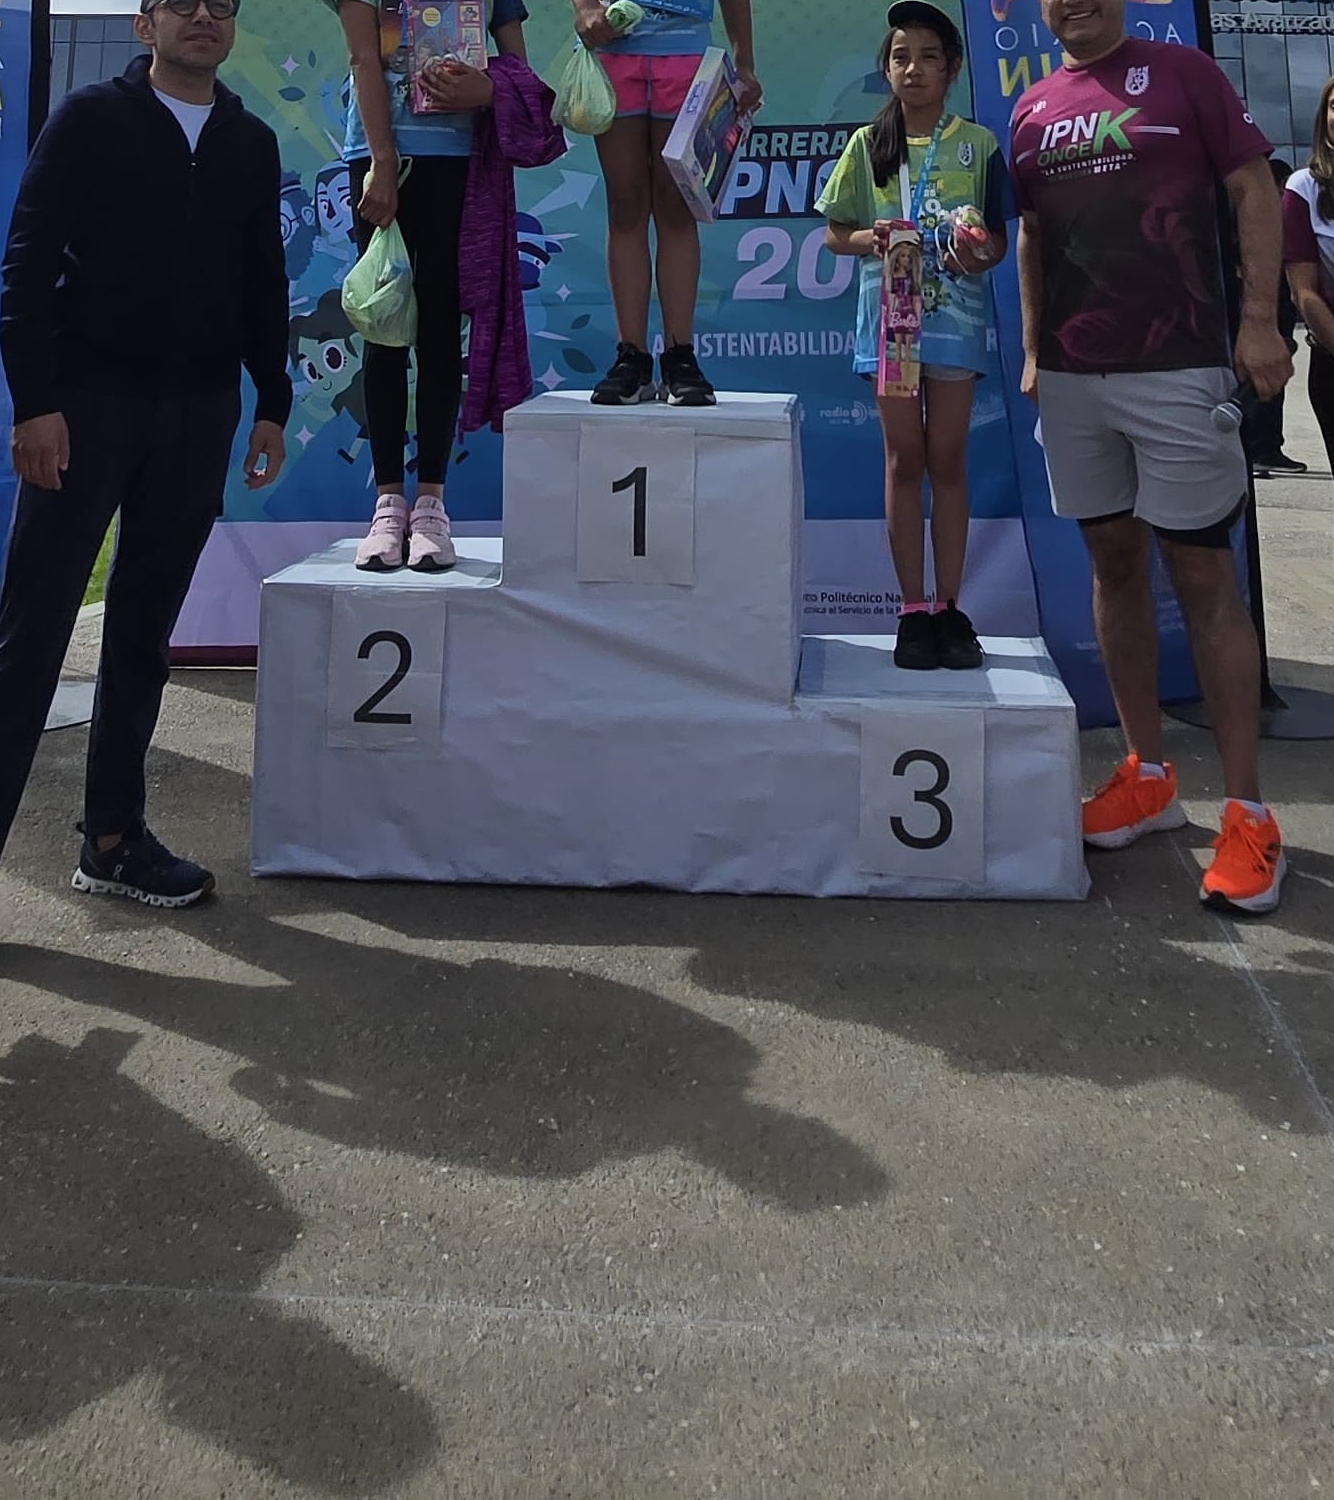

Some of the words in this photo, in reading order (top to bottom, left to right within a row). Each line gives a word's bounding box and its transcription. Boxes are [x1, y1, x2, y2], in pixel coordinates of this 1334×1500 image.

[1040, 112, 1098, 150] IPN
[1037, 140, 1092, 168] ONCE
[889, 311, 919, 329] Barbie
[610, 466, 648, 558] 1
[820, 591, 883, 604] Politécnico
[838, 605, 872, 614] Servicio
[353, 629, 413, 725] 2
[889, 749, 954, 850] 3
